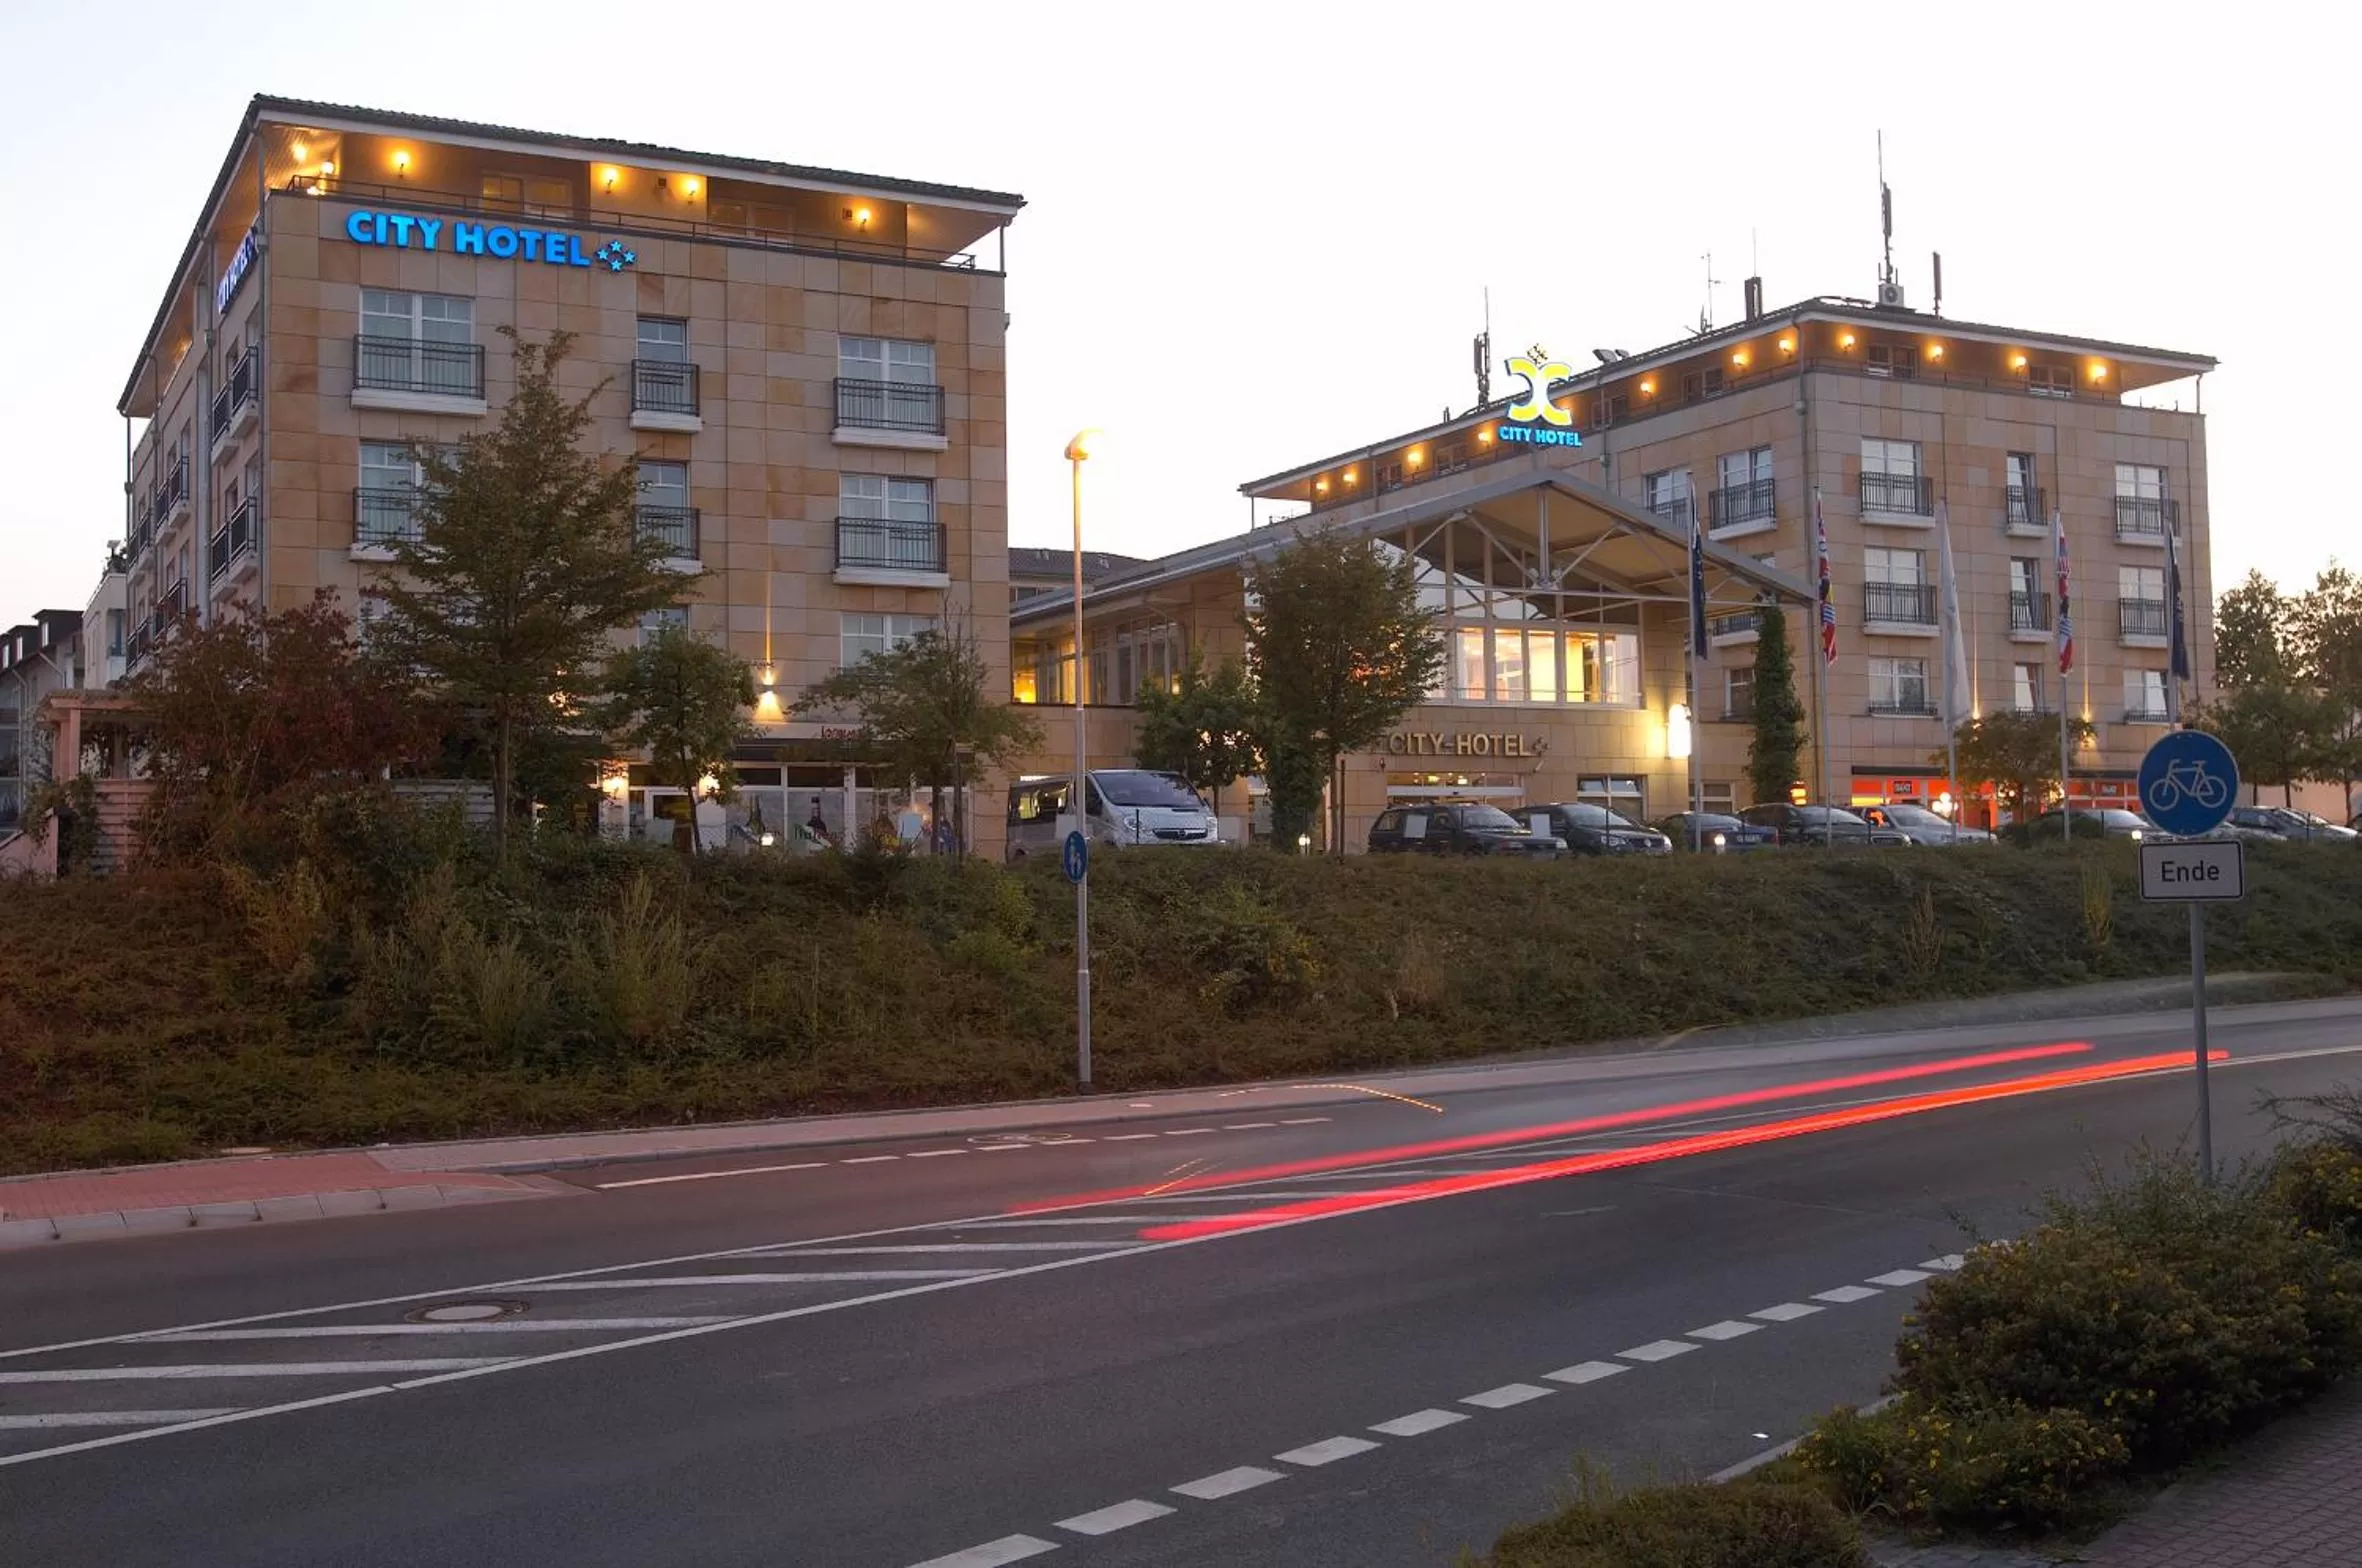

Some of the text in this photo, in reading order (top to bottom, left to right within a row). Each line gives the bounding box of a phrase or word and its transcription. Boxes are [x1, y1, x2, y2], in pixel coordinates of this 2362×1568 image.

[346, 210, 592, 267] CITY HOTEL
[1499, 426, 1582, 447] CITY HOTEL
[1389, 732, 1531, 757] CITY HOTEL
[2161, 860, 2220, 882] Ende
